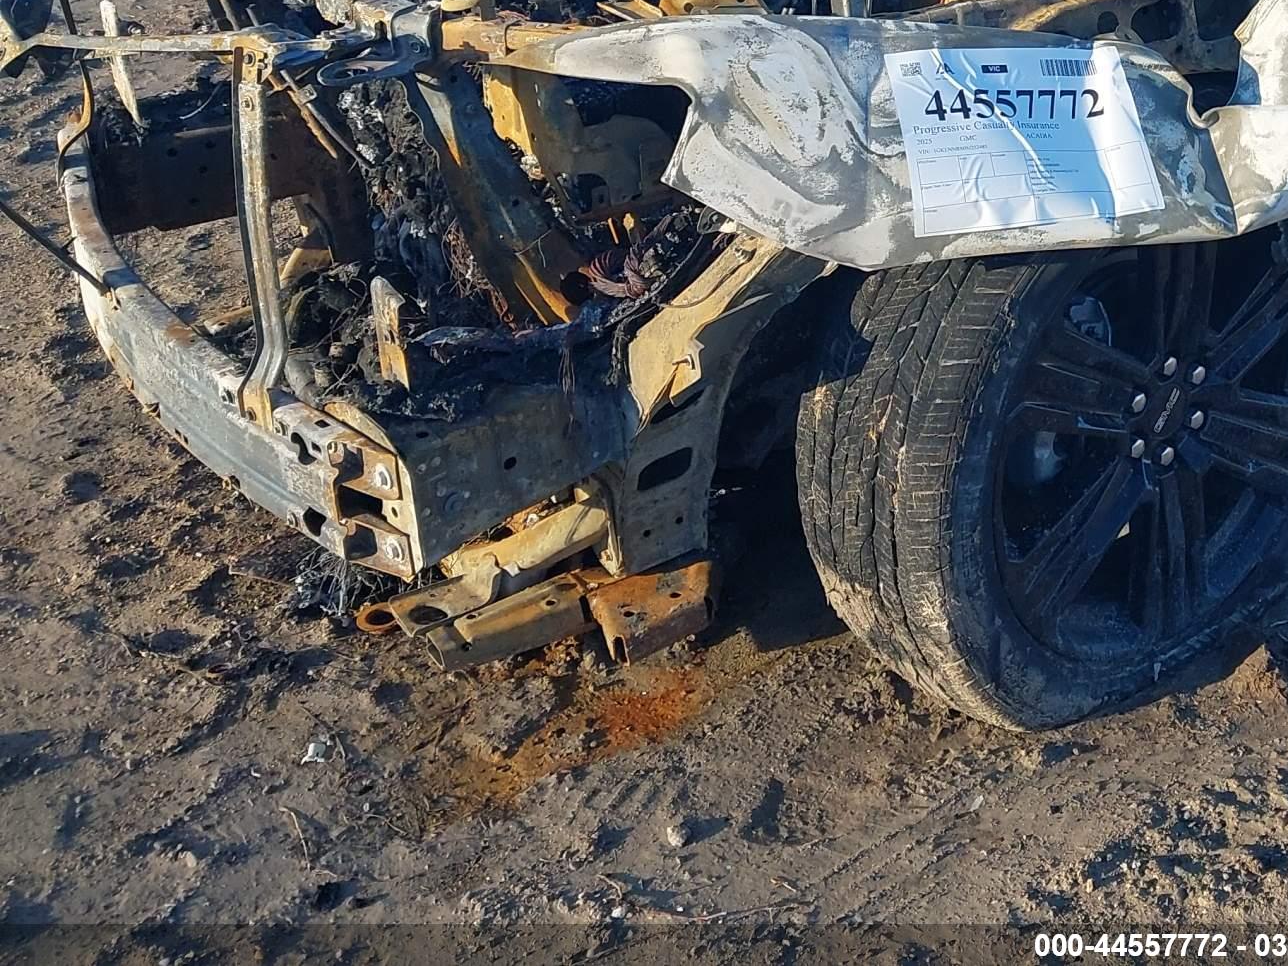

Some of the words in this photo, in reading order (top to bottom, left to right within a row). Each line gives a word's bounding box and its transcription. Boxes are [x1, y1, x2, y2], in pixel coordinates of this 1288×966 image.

[924, 89, 1104, 120] 44557772
[912, 123, 971, 134] Progressive
[1017, 119, 1060, 130] Insurance
[1153, 387, 1180, 434] GMC
